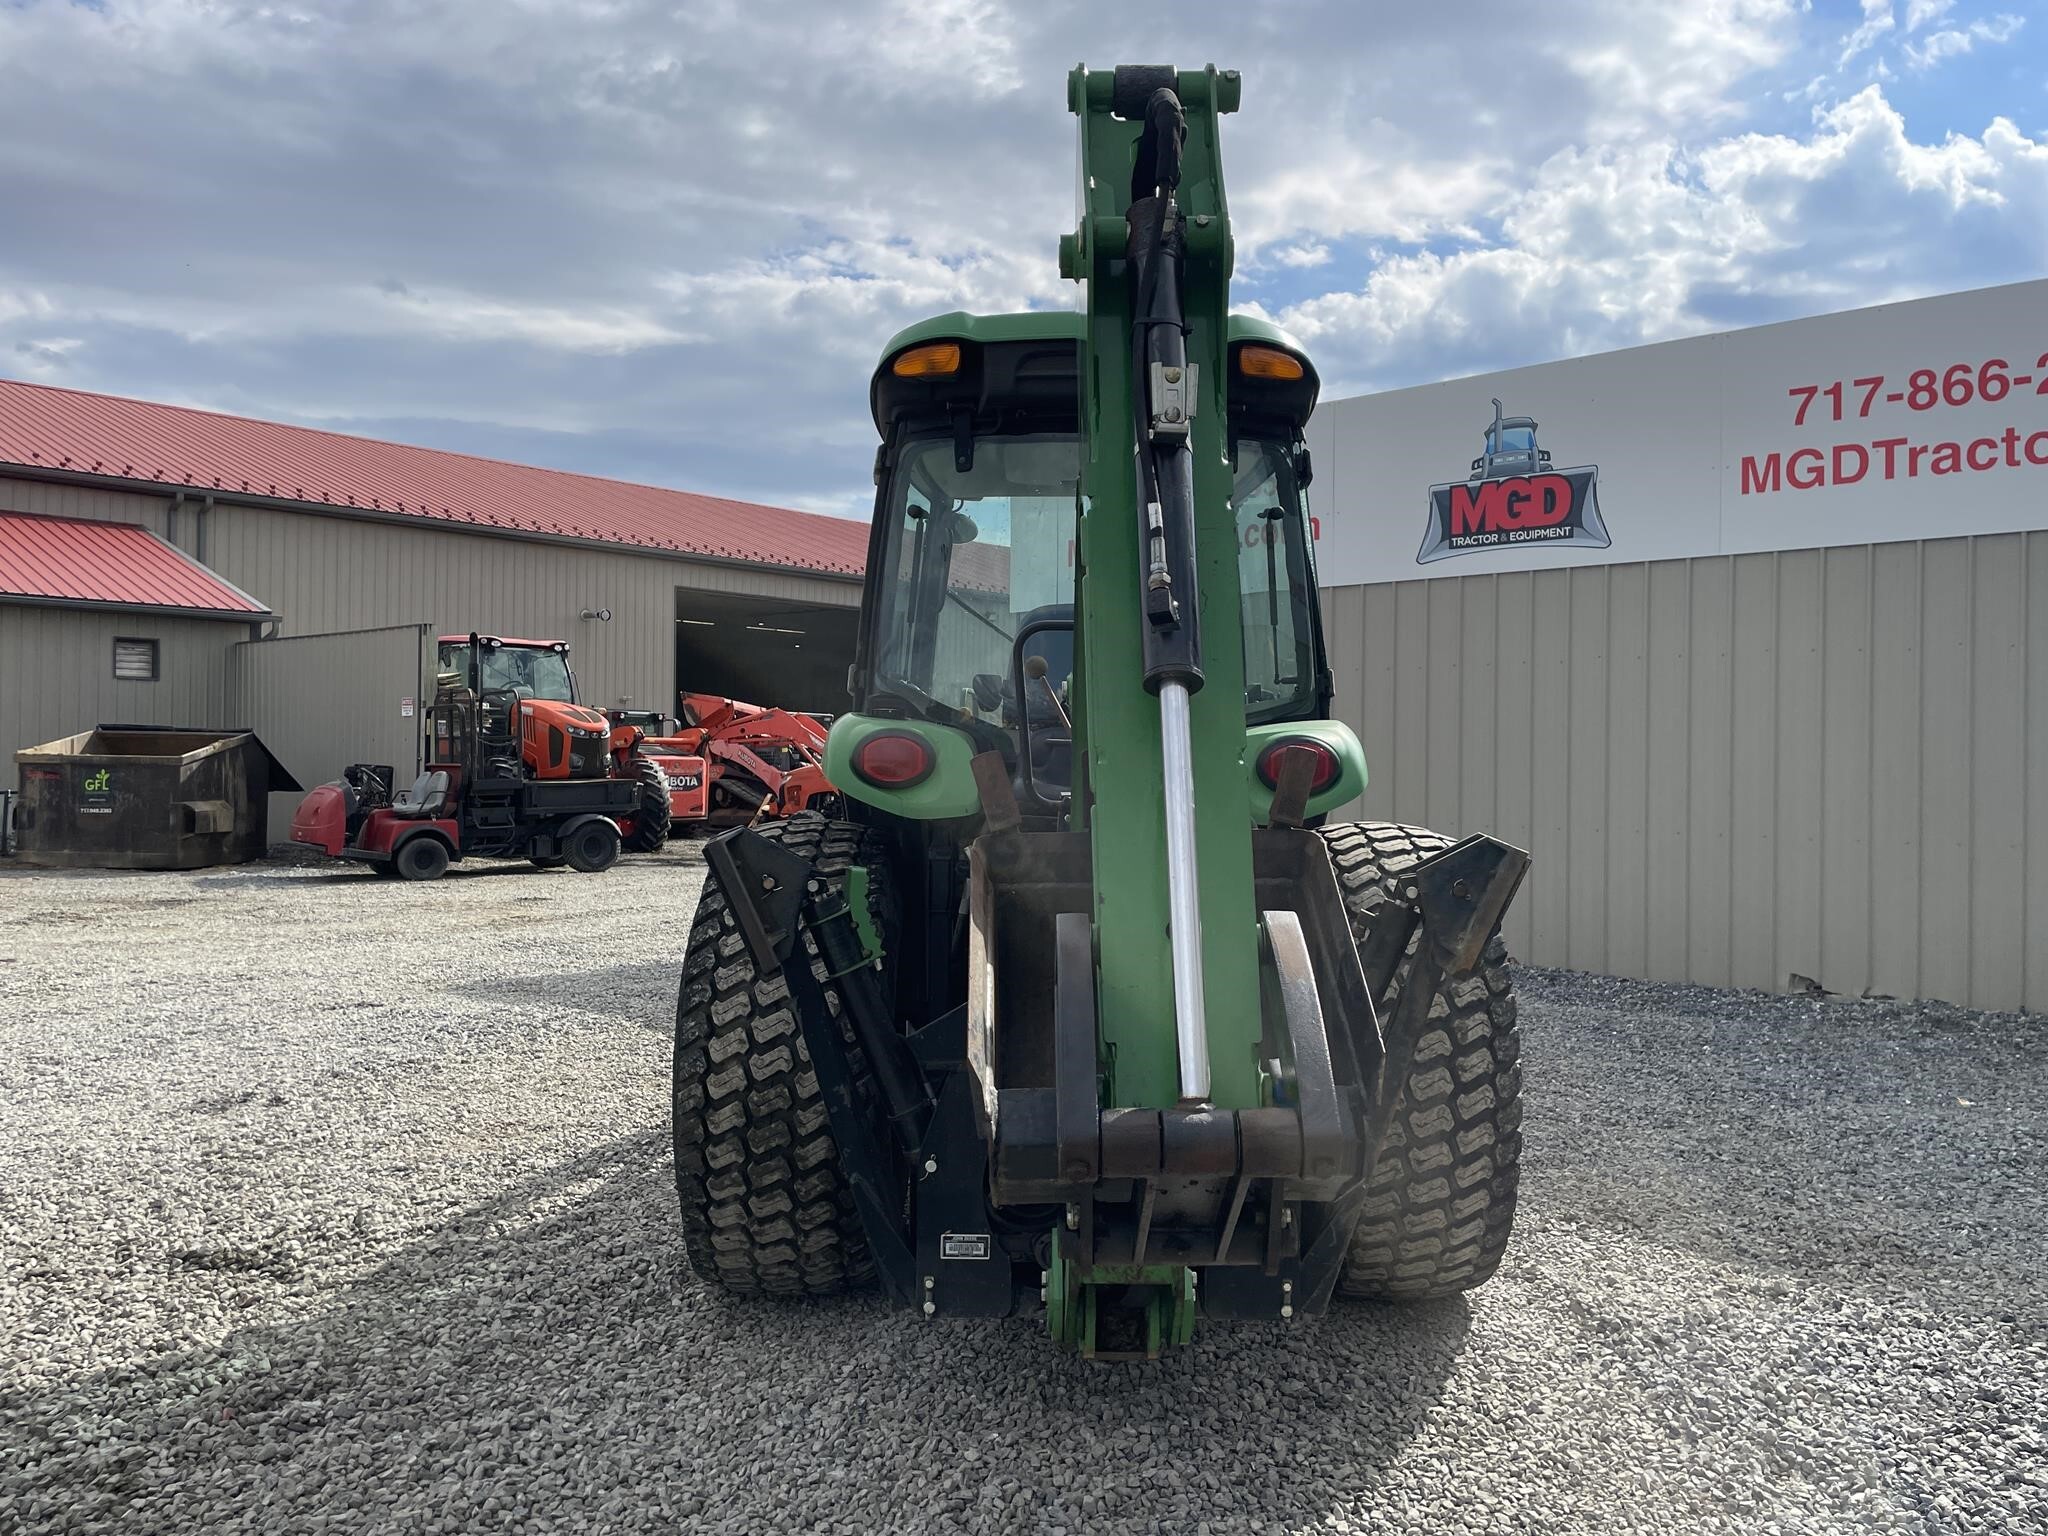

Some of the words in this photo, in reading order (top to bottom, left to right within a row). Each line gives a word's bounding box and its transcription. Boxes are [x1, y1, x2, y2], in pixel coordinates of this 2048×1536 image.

[1451, 474, 1572, 535] MGD
[1451, 533, 1499, 547] TRACTOR
[1500, 533, 1508, 542] &
[1510, 526, 1572, 541] EQUIPMENT
[85, 772, 110, 790] GFL
